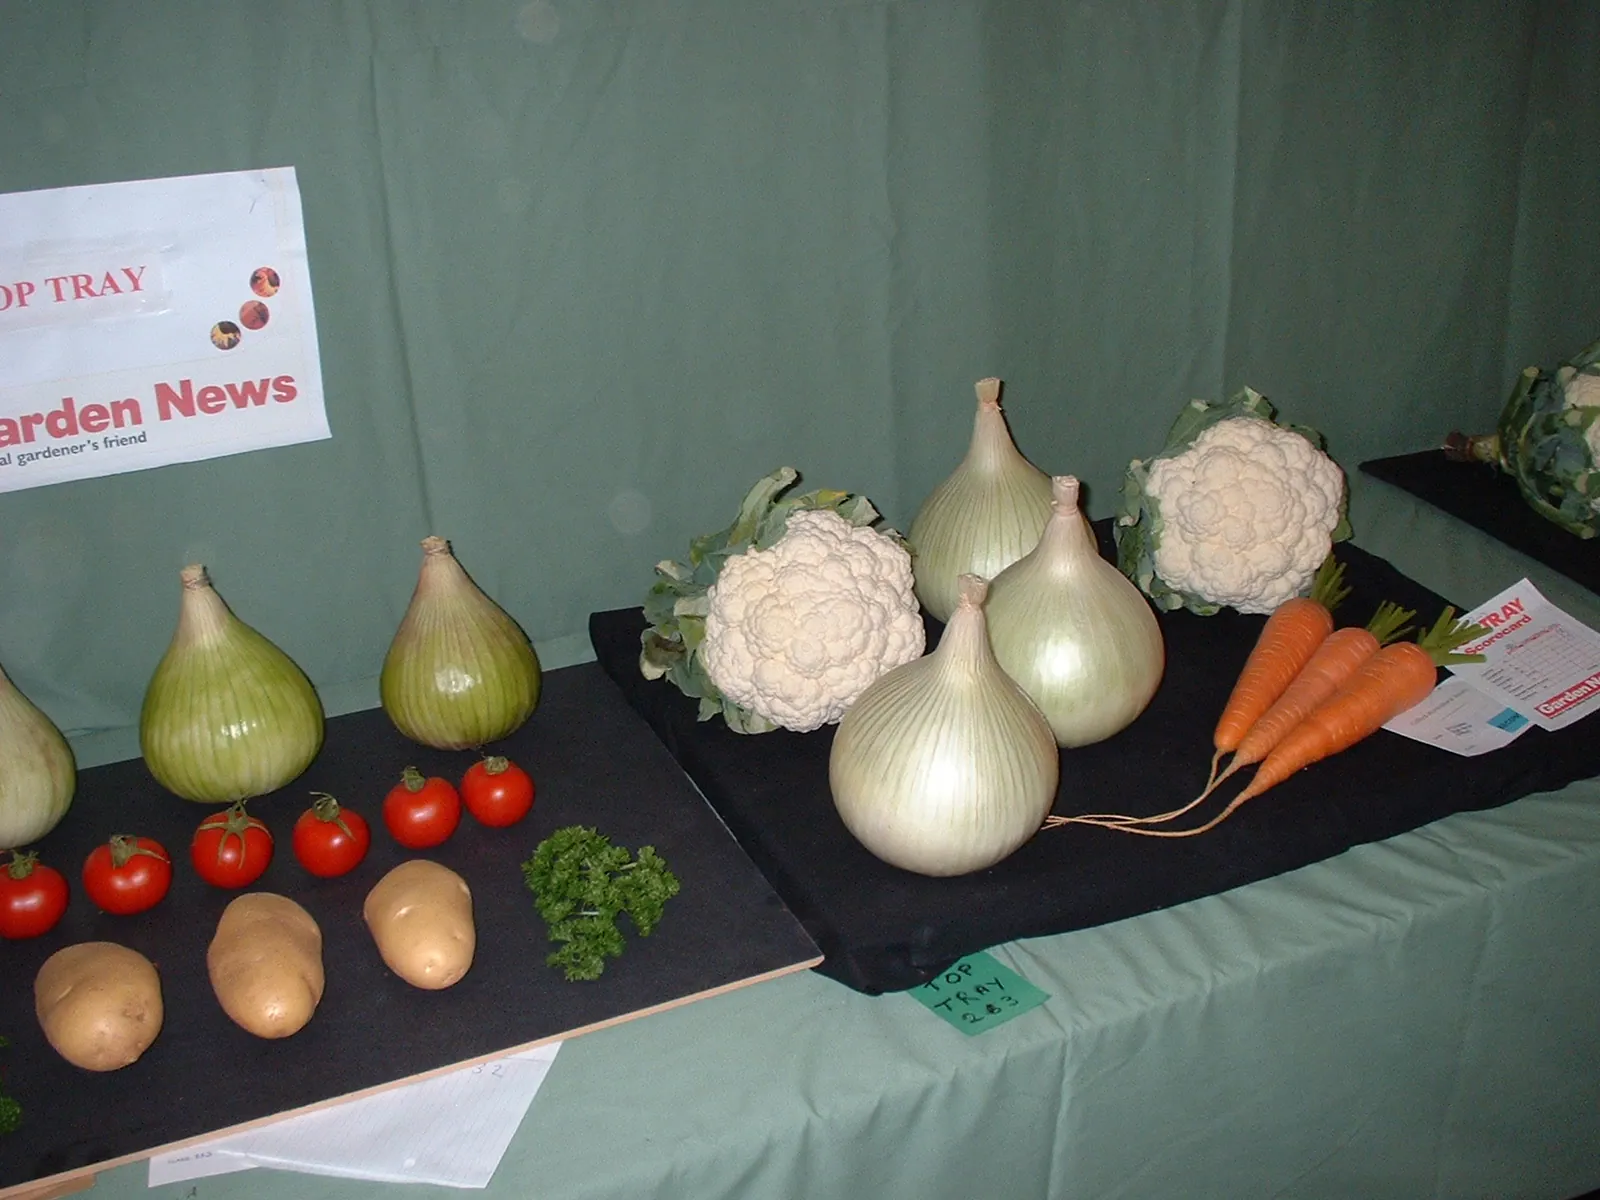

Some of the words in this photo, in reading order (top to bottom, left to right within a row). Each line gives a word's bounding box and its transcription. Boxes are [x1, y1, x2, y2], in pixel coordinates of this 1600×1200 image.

[45, 266, 147, 302] TRAY
[0, 397, 143, 448] arden
[154, 375, 298, 420] News
[17, 440, 100, 466] gardener's
[103, 431, 148, 449] friend
[1478, 598, 1525, 629] TRAY
[1464, 614, 1533, 656] Scorecard
[1539, 684, 1592, 714] Garden
[923, 964, 972, 991] TOP
[933, 976, 1005, 1012] TRAY
